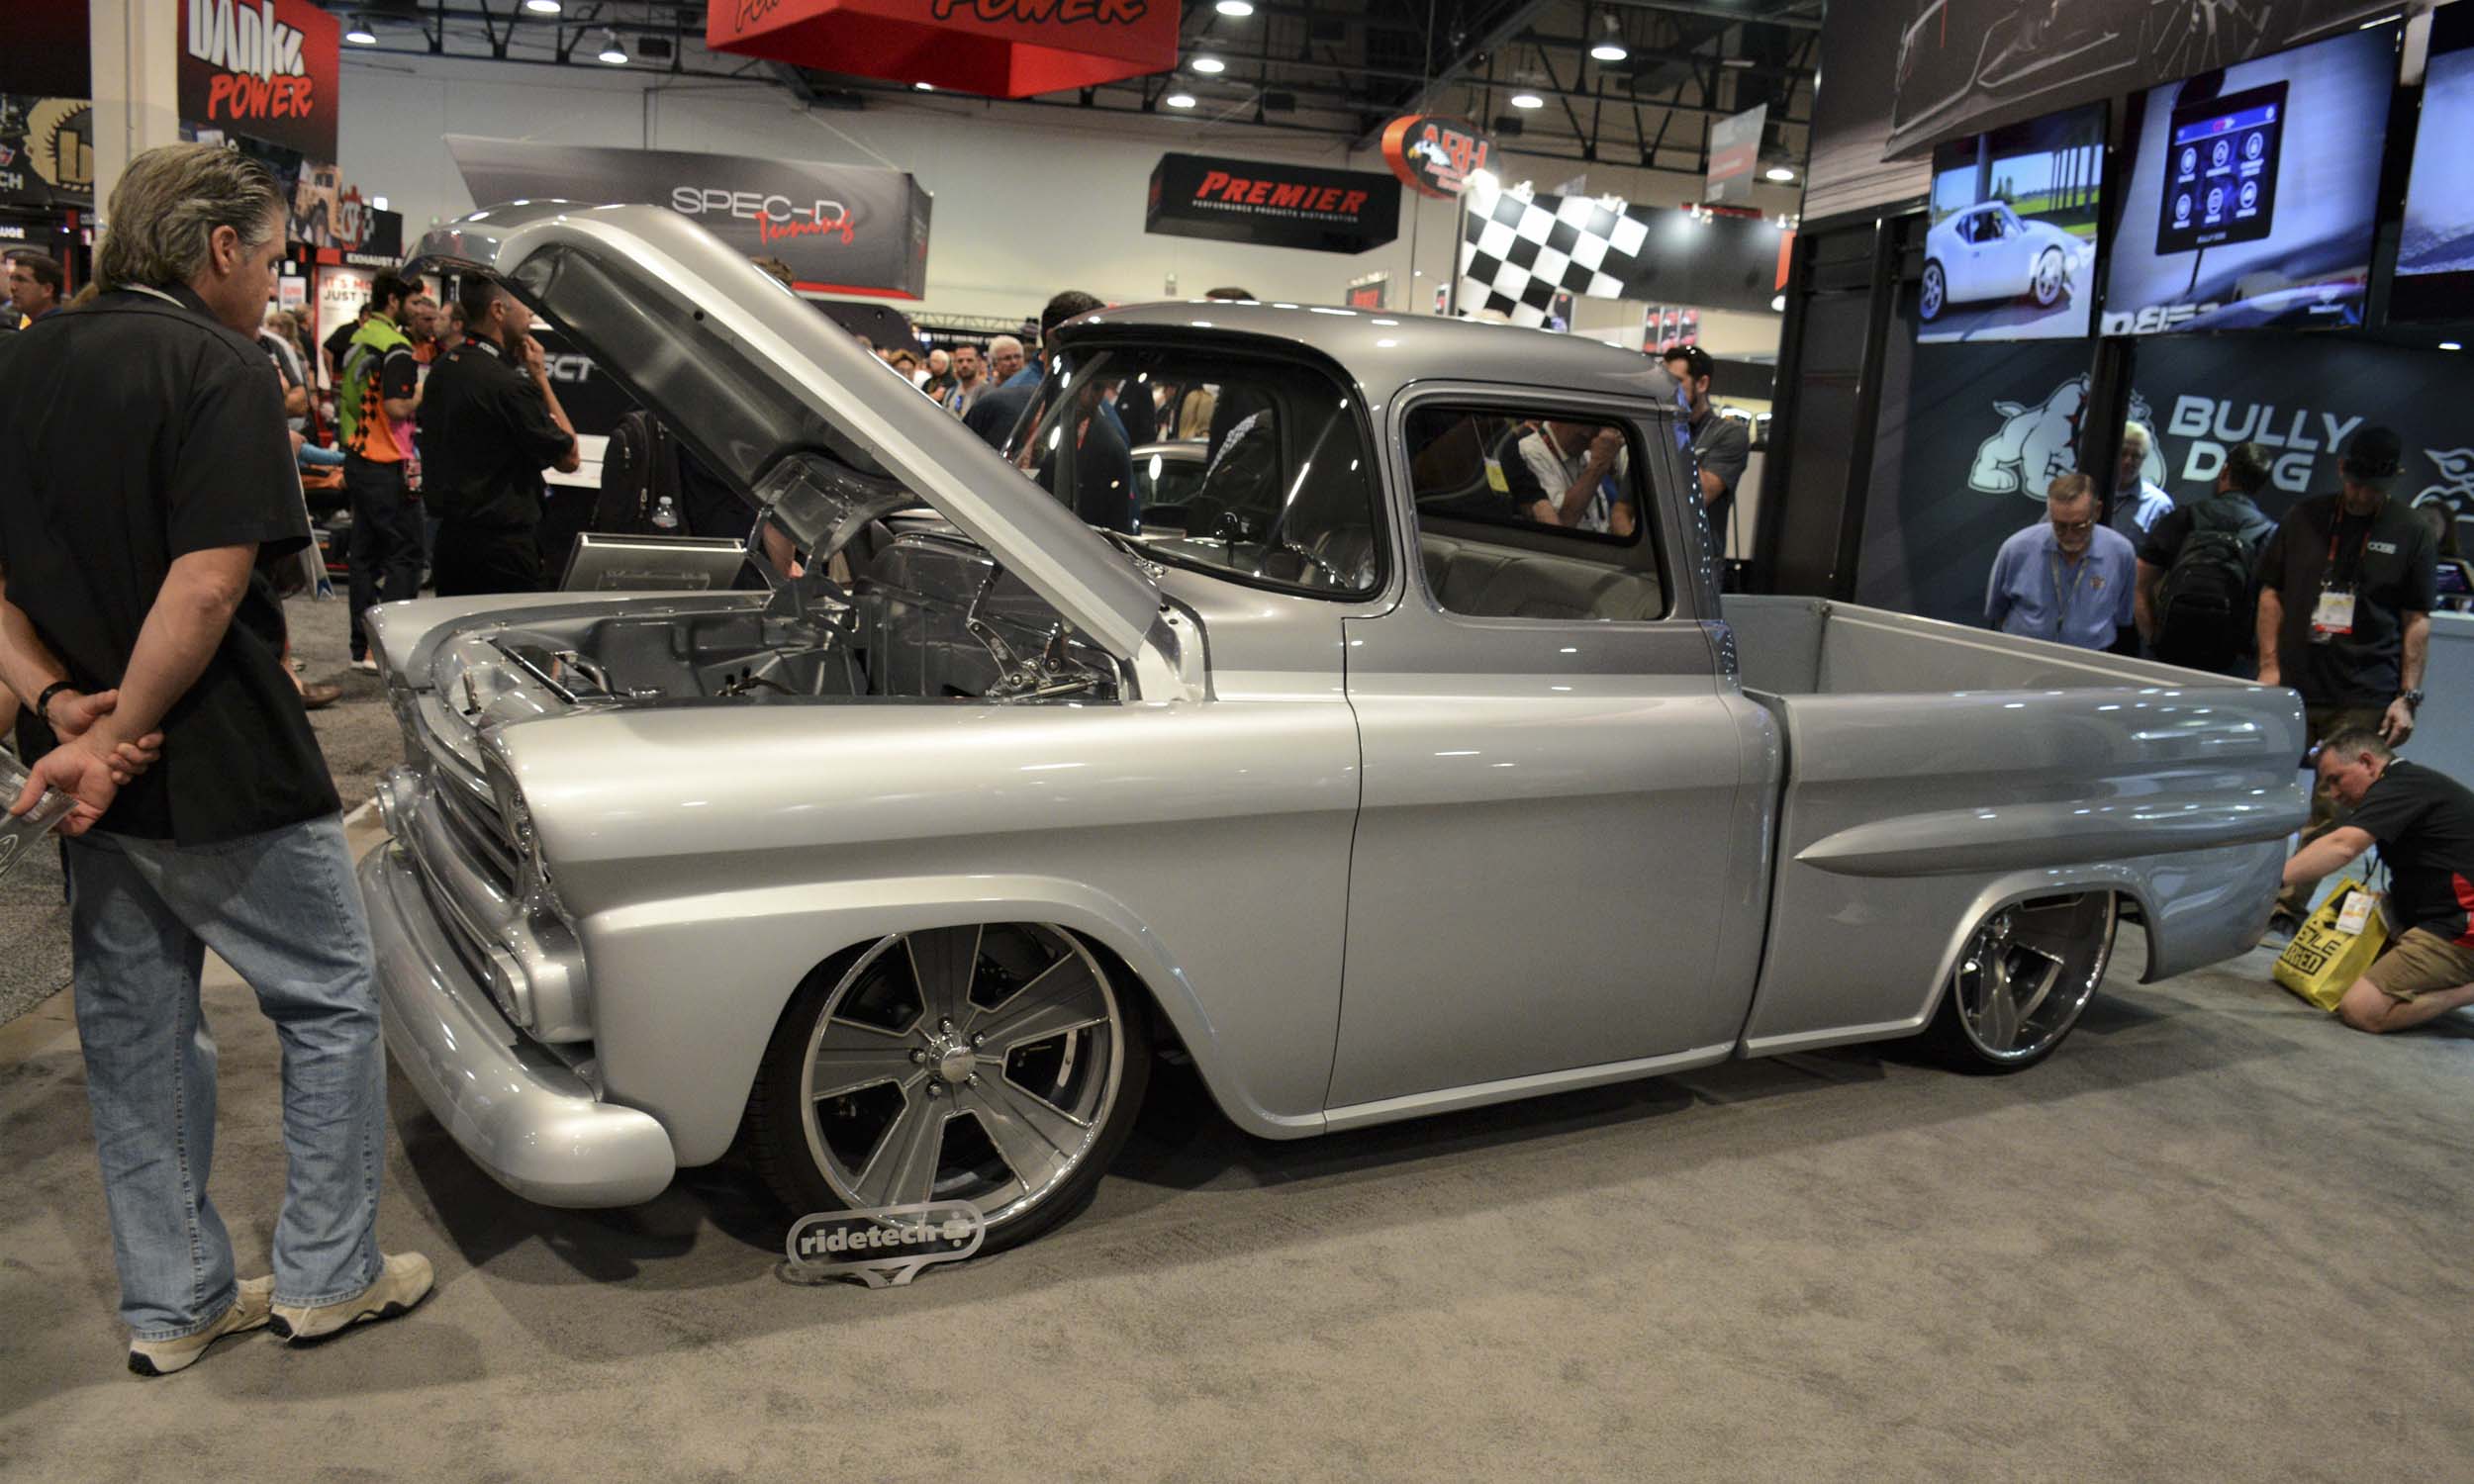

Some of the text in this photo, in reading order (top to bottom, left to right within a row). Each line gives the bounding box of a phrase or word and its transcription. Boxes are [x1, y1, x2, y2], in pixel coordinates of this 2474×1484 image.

[208, 72, 314, 120] POWER
[672, 186, 846, 226] SPEC-D
[1196, 171, 1368, 216] PREMIER
[754, 208, 855, 246] Tuning
[2167, 394, 2364, 453] BULLY
[2181, 440, 2316, 493] DG
[800, 1220, 937, 1255] ridetech
